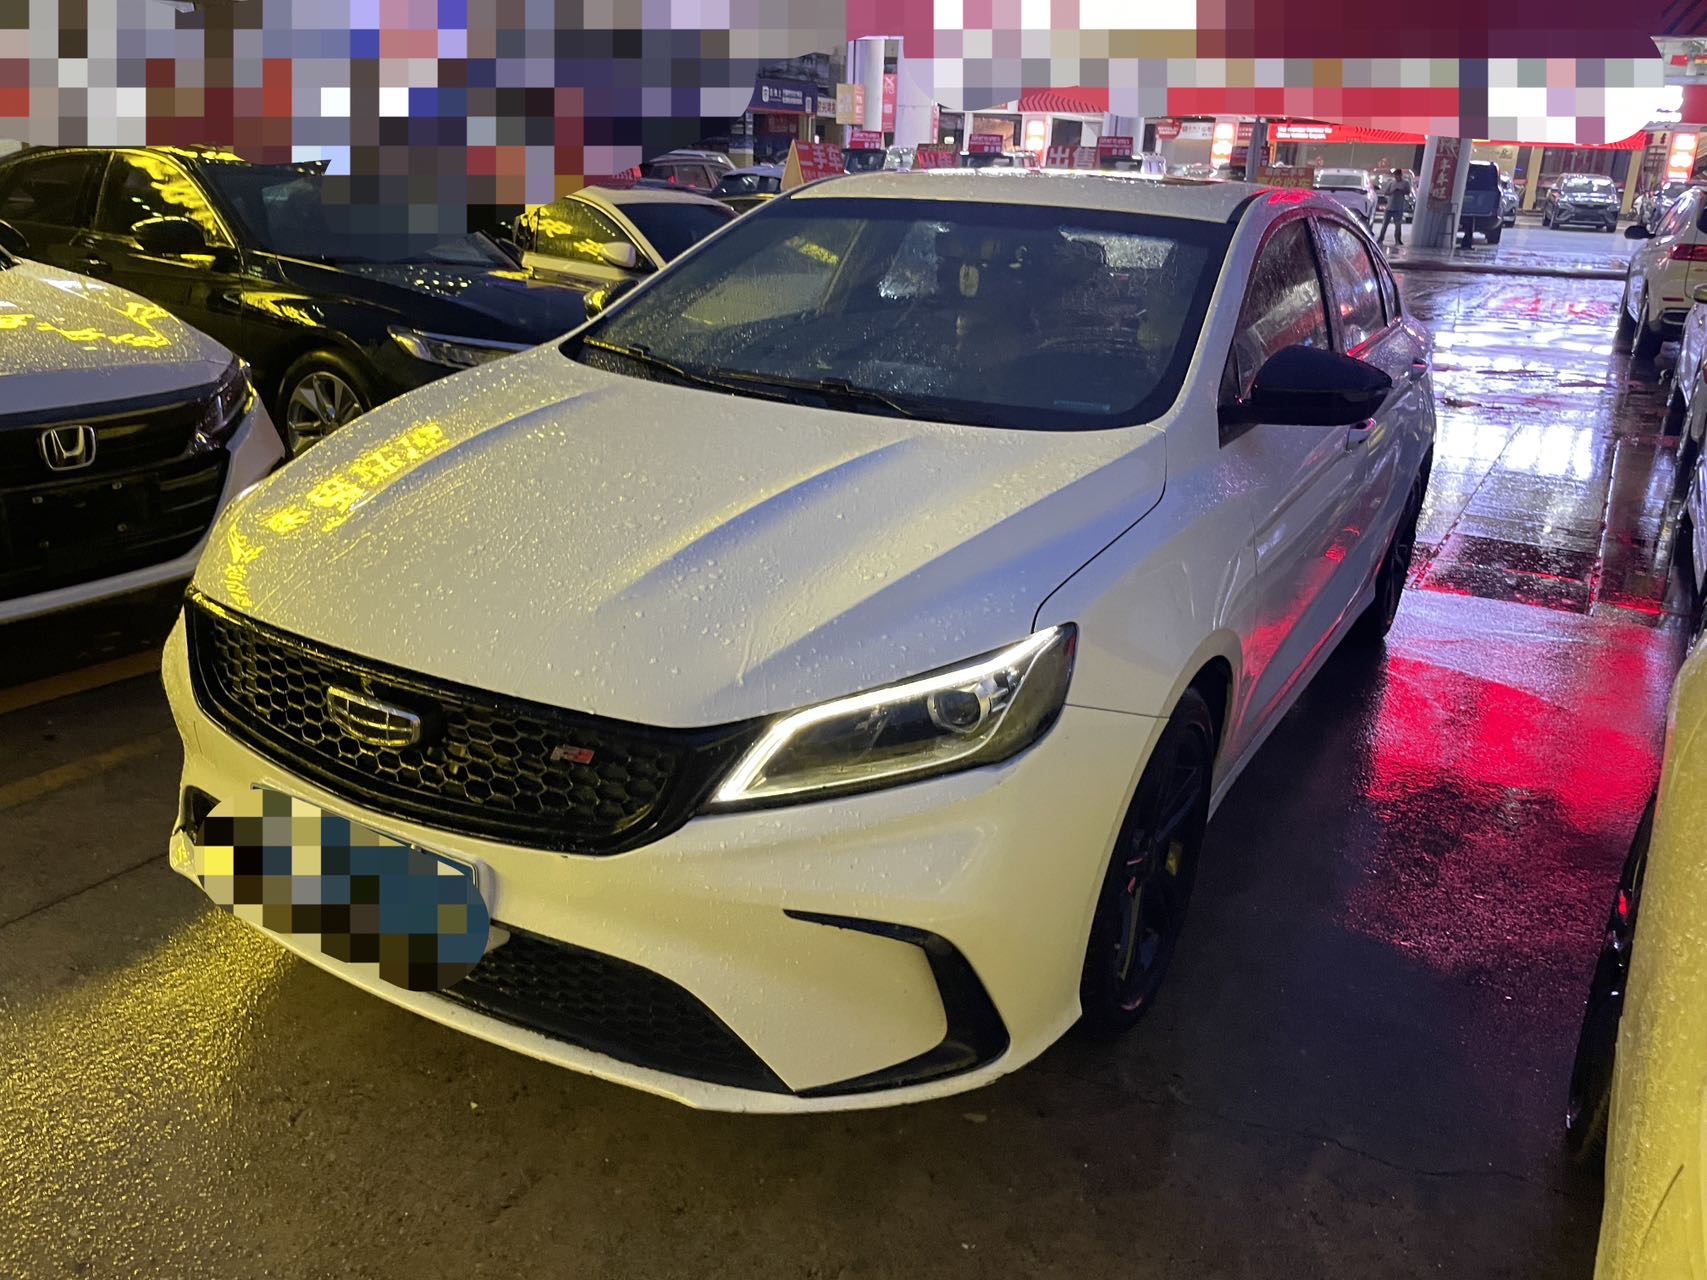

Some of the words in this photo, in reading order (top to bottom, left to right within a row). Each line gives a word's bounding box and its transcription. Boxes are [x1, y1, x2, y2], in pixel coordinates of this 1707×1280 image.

[797, 143, 844, 171] 二手车
[1047, 145, 1096, 169] 出售
